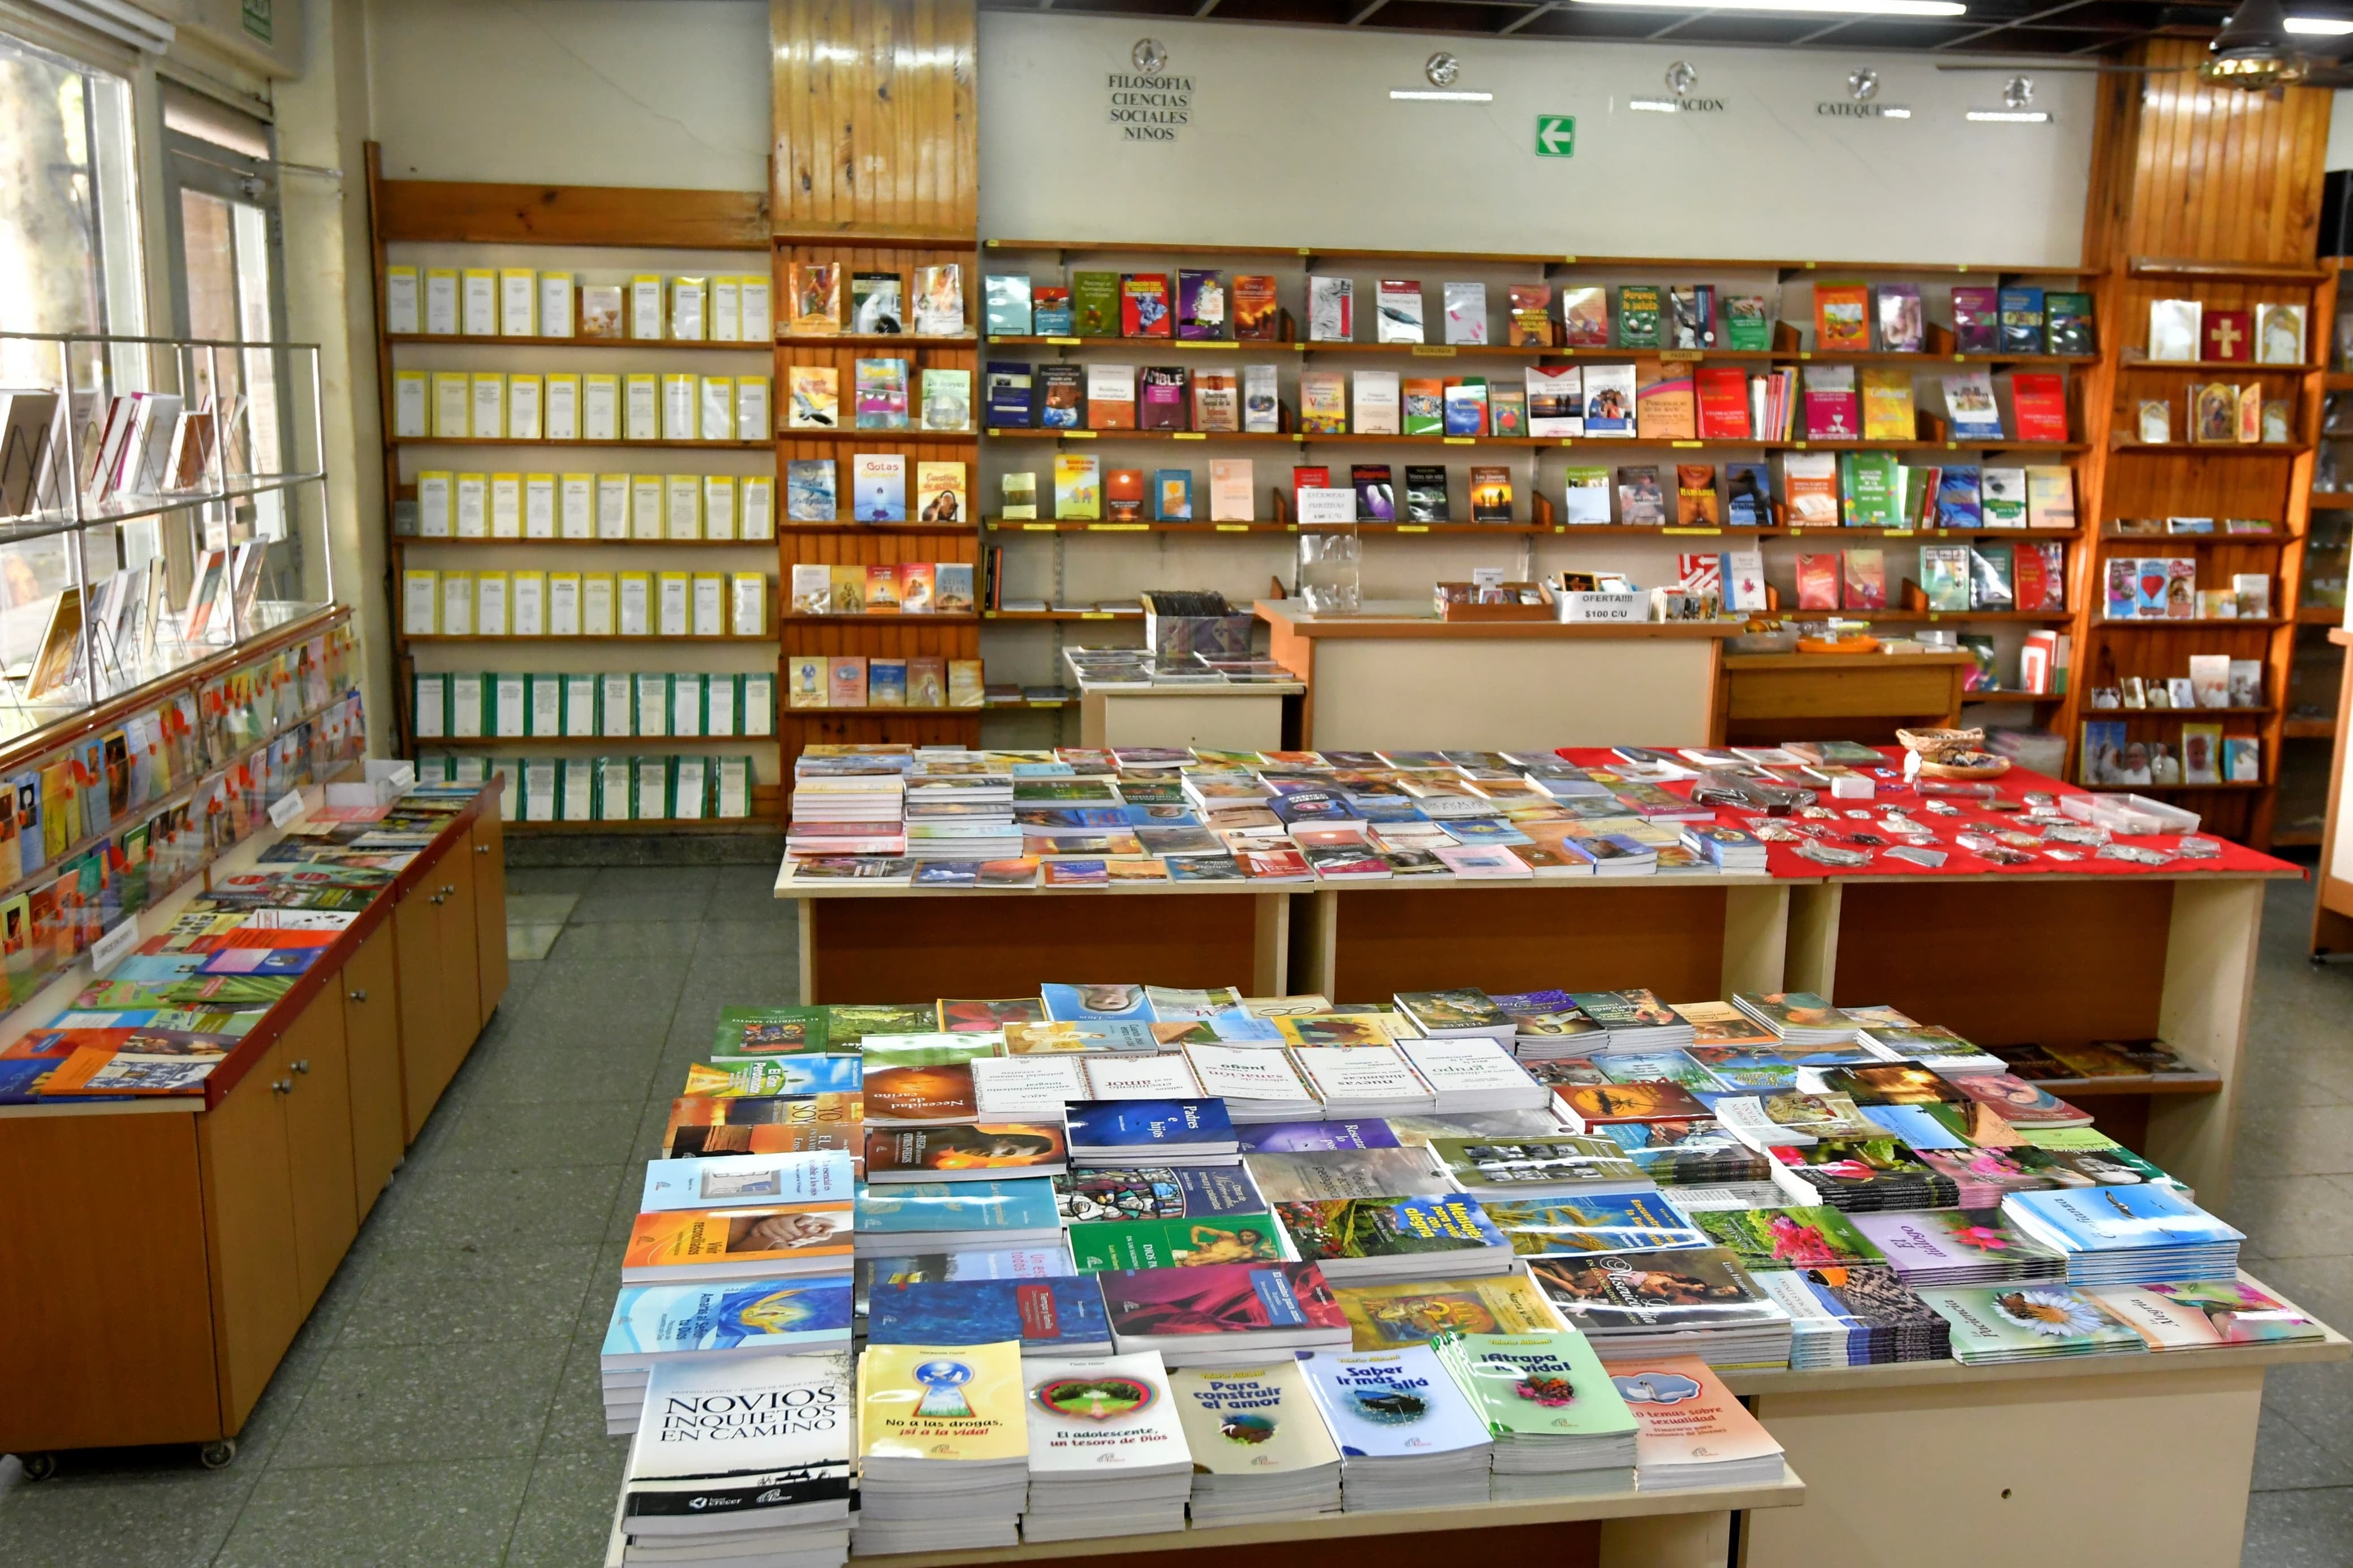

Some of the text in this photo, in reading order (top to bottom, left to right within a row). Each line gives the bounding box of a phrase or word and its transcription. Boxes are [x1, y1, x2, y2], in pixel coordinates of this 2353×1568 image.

[1109, 75, 1191, 90] FILOSOFIA
[1113, 93, 1187, 106] CIENCIAS
[1111, 109, 1187, 124] SOCIALES
[1818, 102, 1904, 118] CATEQUE
[1125, 126, 1174, 140] NIÑOS
[867, 461, 899, 472] Gotas
[1209, 1070, 1283, 1079] sanación
[1433, 1065, 1484, 1074] grupo
[748, 1062, 766, 1094] Perdonador
[766, 1075, 781, 1088] Gran
[891, 1099, 964, 1109] Necesidad
[792, 1104, 816, 1124] SOY
[818, 1106, 843, 1122] YO
[1183, 1105, 1200, 1129] Padres
[1147, 1121, 1166, 1138] hijos
[1344, 1124, 1367, 1149] Rescatar
[818, 1135, 832, 1145] EL
[915, 1135, 926, 1150] FUEGO
[902, 1133, 913, 1164] OTROS FUEGOS
[822, 1167, 832, 1186] esencial
[1404, 1207, 1437, 1238] alegría
[1426, 1216, 1442, 1228] con
[1430, 1206, 1463, 1237] para vivir
[1445, 1202, 1484, 1238] Mensajes
[687, 1222, 705, 1256] reconciliados
[1889, 1238, 1916, 1249] El
[1901, 1225, 1947, 1258] diálogo
[706, 1241, 722, 1255] Vivir
[1143, 1244, 1155, 1260] DIOS
[1011, 1252, 1028, 1272] todos
[1031, 1254, 1045, 1264] Un
[1590, 1267, 1601, 1277] LAS
[1596, 1277, 1615, 1299] SAGRADAS
[1722, 1261, 1755, 1298] LUIS HERIBERTO
[1272, 1271, 1283, 1280] El
[1281, 1298, 1296, 1310] para
[699, 1293, 714, 1315] Amarás
[1040, 1292, 1051, 1310] Tiempo
[1507, 1292, 1523, 1310] Marta
[1943, 1299, 2001, 1338] Paciencia
[2130, 1298, 2181, 1327] Alegría
[676, 1327, 692, 1340] Dios
[693, 1322, 710, 1339] Señor
[1480, 1354, 1558, 1363] ¡Atrapa
[1347, 1366, 1403, 1377] Saber
[1522, 1362, 1571, 1373] vida!
[1209, 1381, 1260, 1392] Para
[1357, 1374, 1395, 1385] más
[1390, 1377, 1430, 1390] allá
[664, 1385, 837, 1415] NOVIOS
[1193, 1386, 1282, 1399] construir
[1201, 1396, 1281, 1409] el amor
[662, 1405, 836, 1428] INQUIETOS
[1688, 1406, 1723, 1415] sobre
[886, 1418, 904, 1427] No
[949, 1418, 1003, 1429] drogas,
[1650, 1414, 1718, 1426] sexualidad
[660, 1418, 836, 1442] EN CAMINO
[953, 1428, 989, 1436] vida!
[1073, 1427, 1158, 1439] adolescente,
[1696, 1428, 1727, 1437] jóvenes
[1072, 1437, 1119, 1446] tesoro
[1140, 1433, 1168, 1442] Dios
[708, 1497, 742, 1506] crecer
